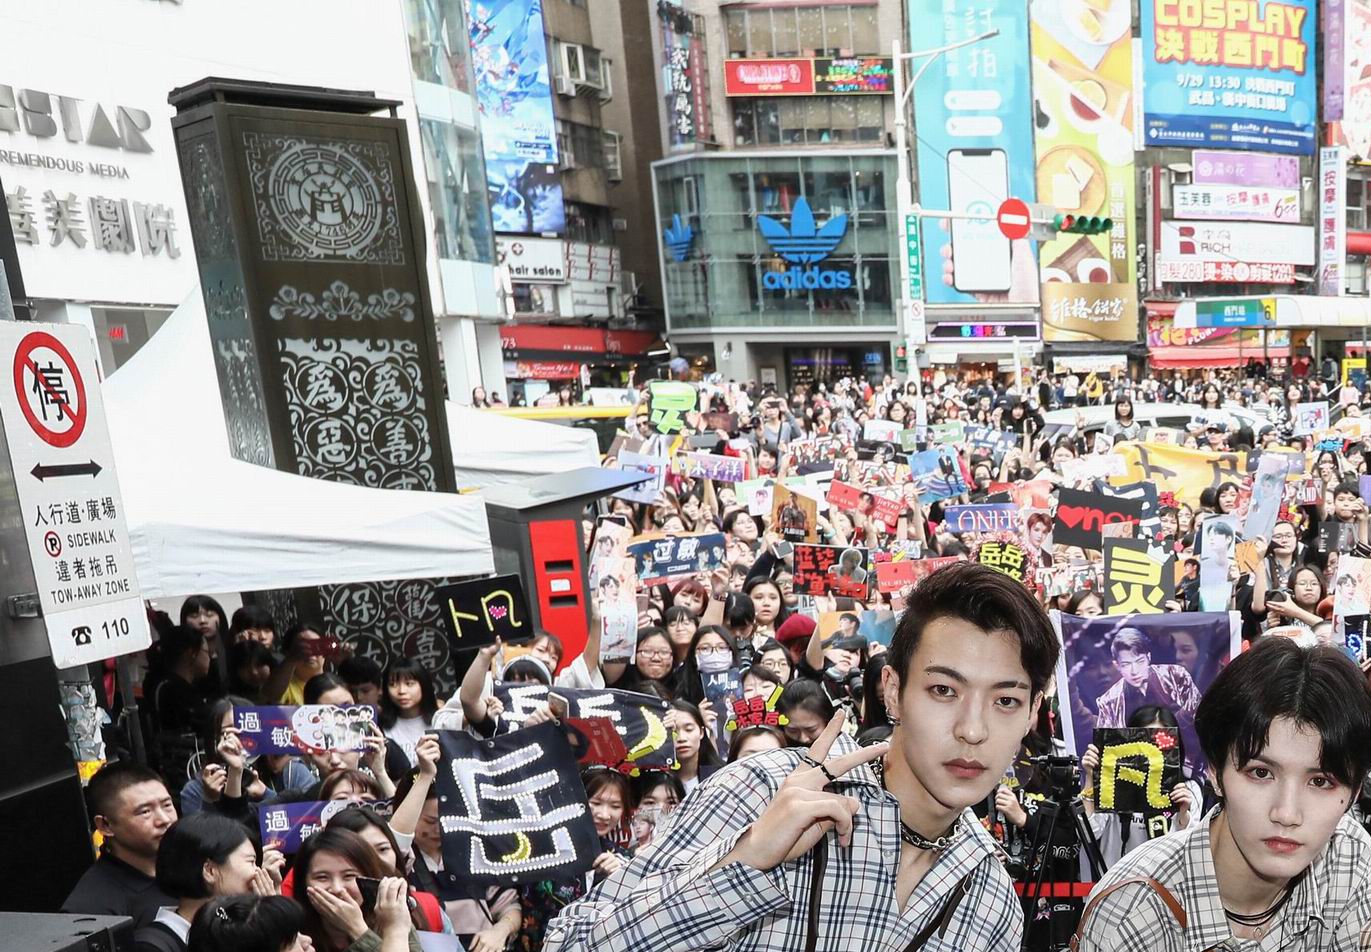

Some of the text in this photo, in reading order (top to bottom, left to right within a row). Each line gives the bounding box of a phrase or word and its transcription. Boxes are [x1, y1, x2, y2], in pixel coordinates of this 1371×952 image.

[1155, 0, 1306, 38] COSPLAY
[1156, 29, 1306, 74] 決戰西門町
[1209, 75, 1241, 89] 13:30
[88, 161, 130, 180] MEDIA
[508, 265, 562, 277] hair salon
[763, 266, 851, 290] adidas
[1264, 304, 1271, 321] 6
[32, 361, 70, 421] 停
[68, 529, 117, 548] SIDEWALK
[653, 537, 701, 563] 过敏
[55, 554, 119, 582] 違者拖吊
[979, 542, 1024, 569] 岳岳
[51, 578, 131, 604] TOW-AWAY ZONE
[102, 617, 130, 640] 110
[1099, 741, 1173, 810] 凡
[439, 742, 585, 876] 岳
